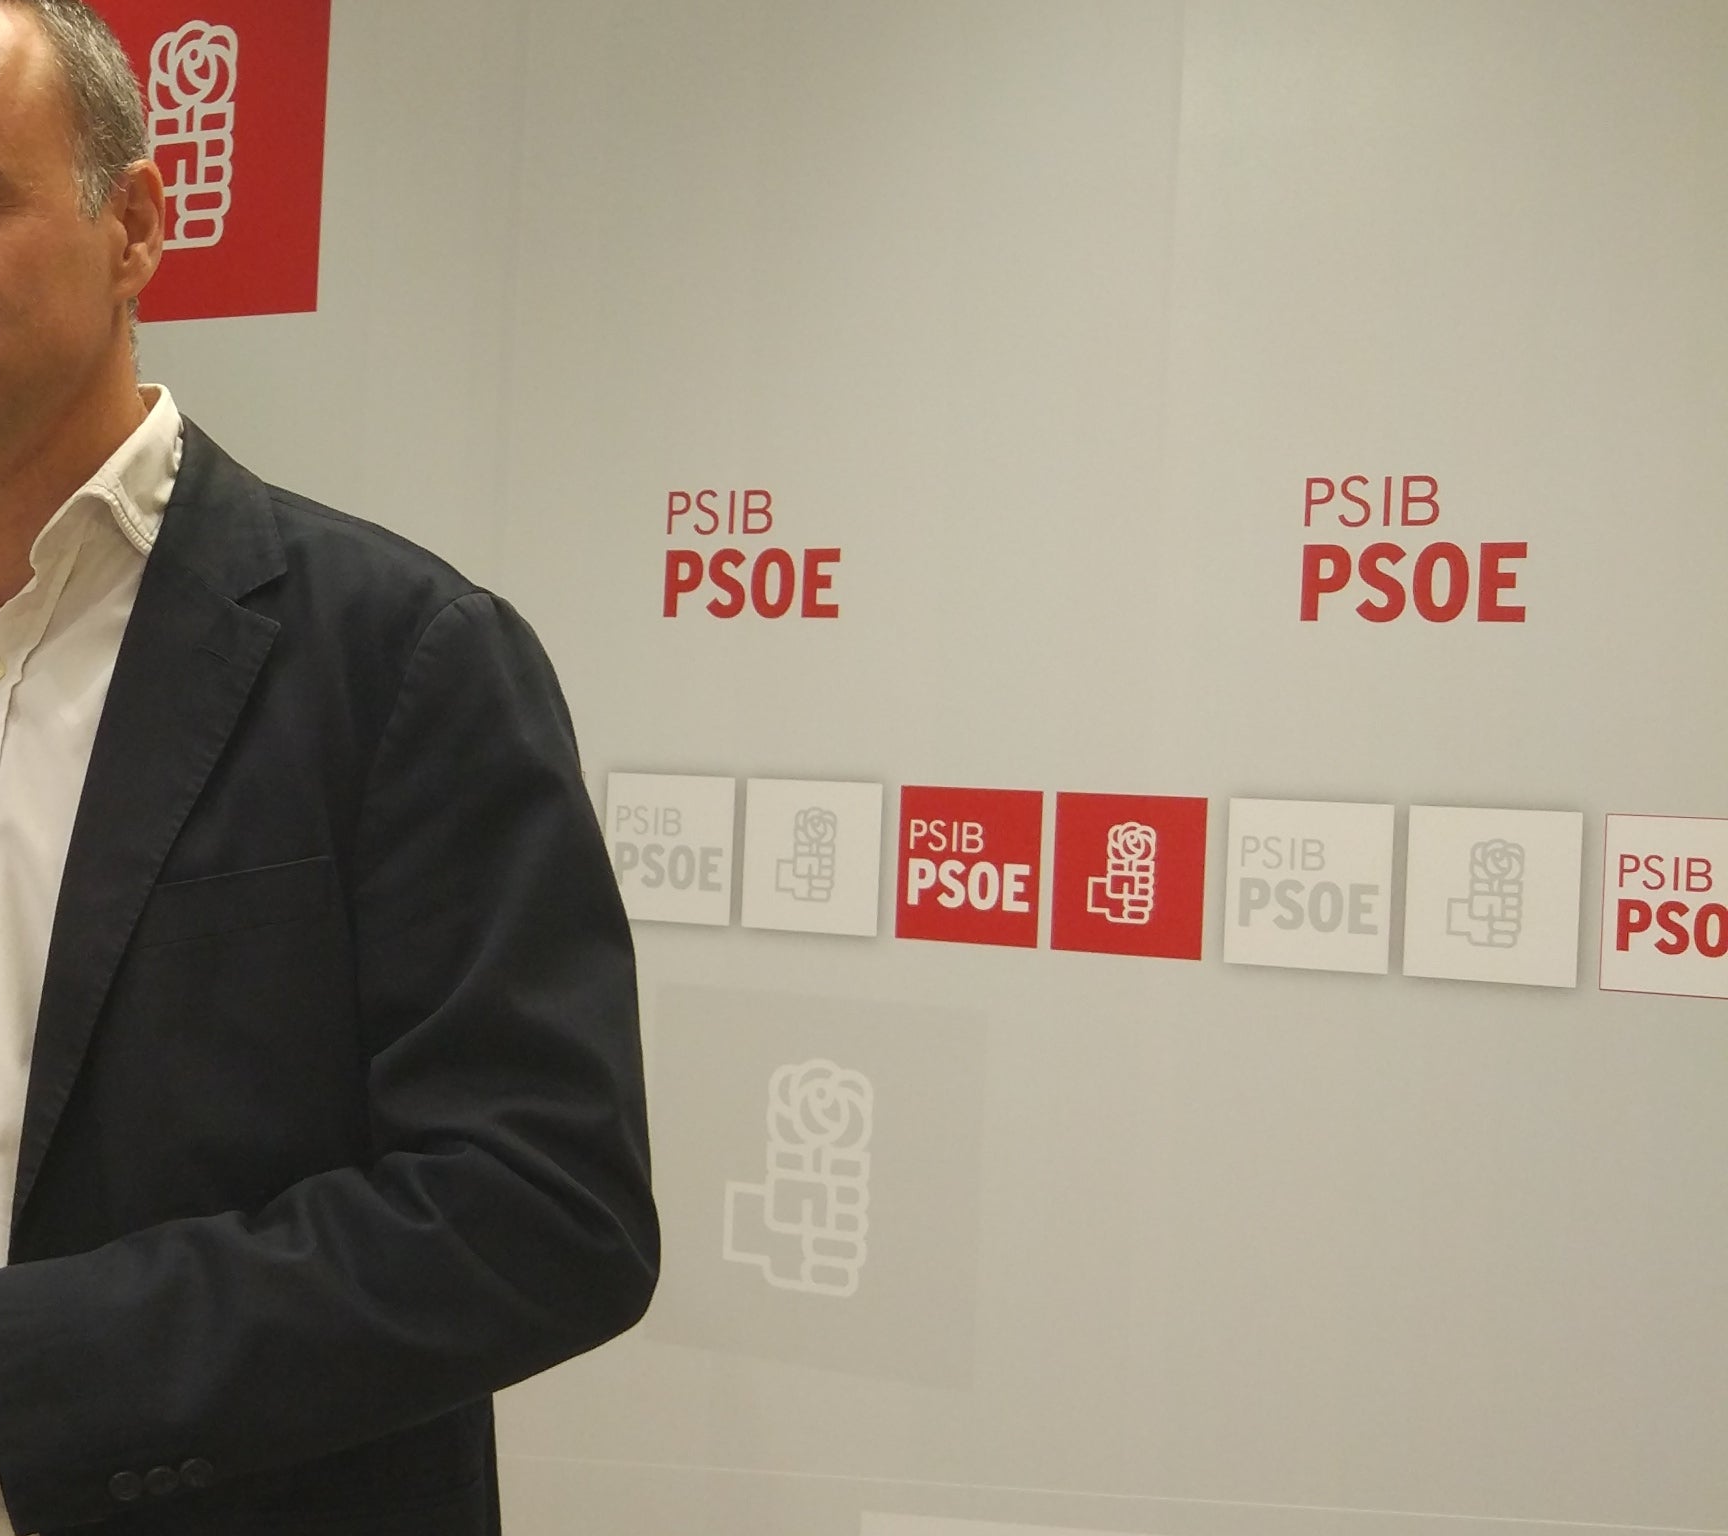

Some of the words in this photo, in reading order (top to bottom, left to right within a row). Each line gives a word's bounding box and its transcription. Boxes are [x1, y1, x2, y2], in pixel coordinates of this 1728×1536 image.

[667, 489, 773, 535] PSIB
[1304, 474, 1440, 528] PSIB
[663, 547, 841, 619] PSOE
[1300, 541, 1528, 623] PSOE
[615, 805, 682, 836] PSIB
[909, 819, 984, 853] PSIB
[614, 841, 723, 892] PSOE
[1241, 835, 1326, 871] PSIB
[1618, 854, 1713, 892] PSIB
[907, 857, 1030, 913] PSOE
[1238, 877, 1380, 935] PSOE
[1616, 898, 1728, 958] PSO
